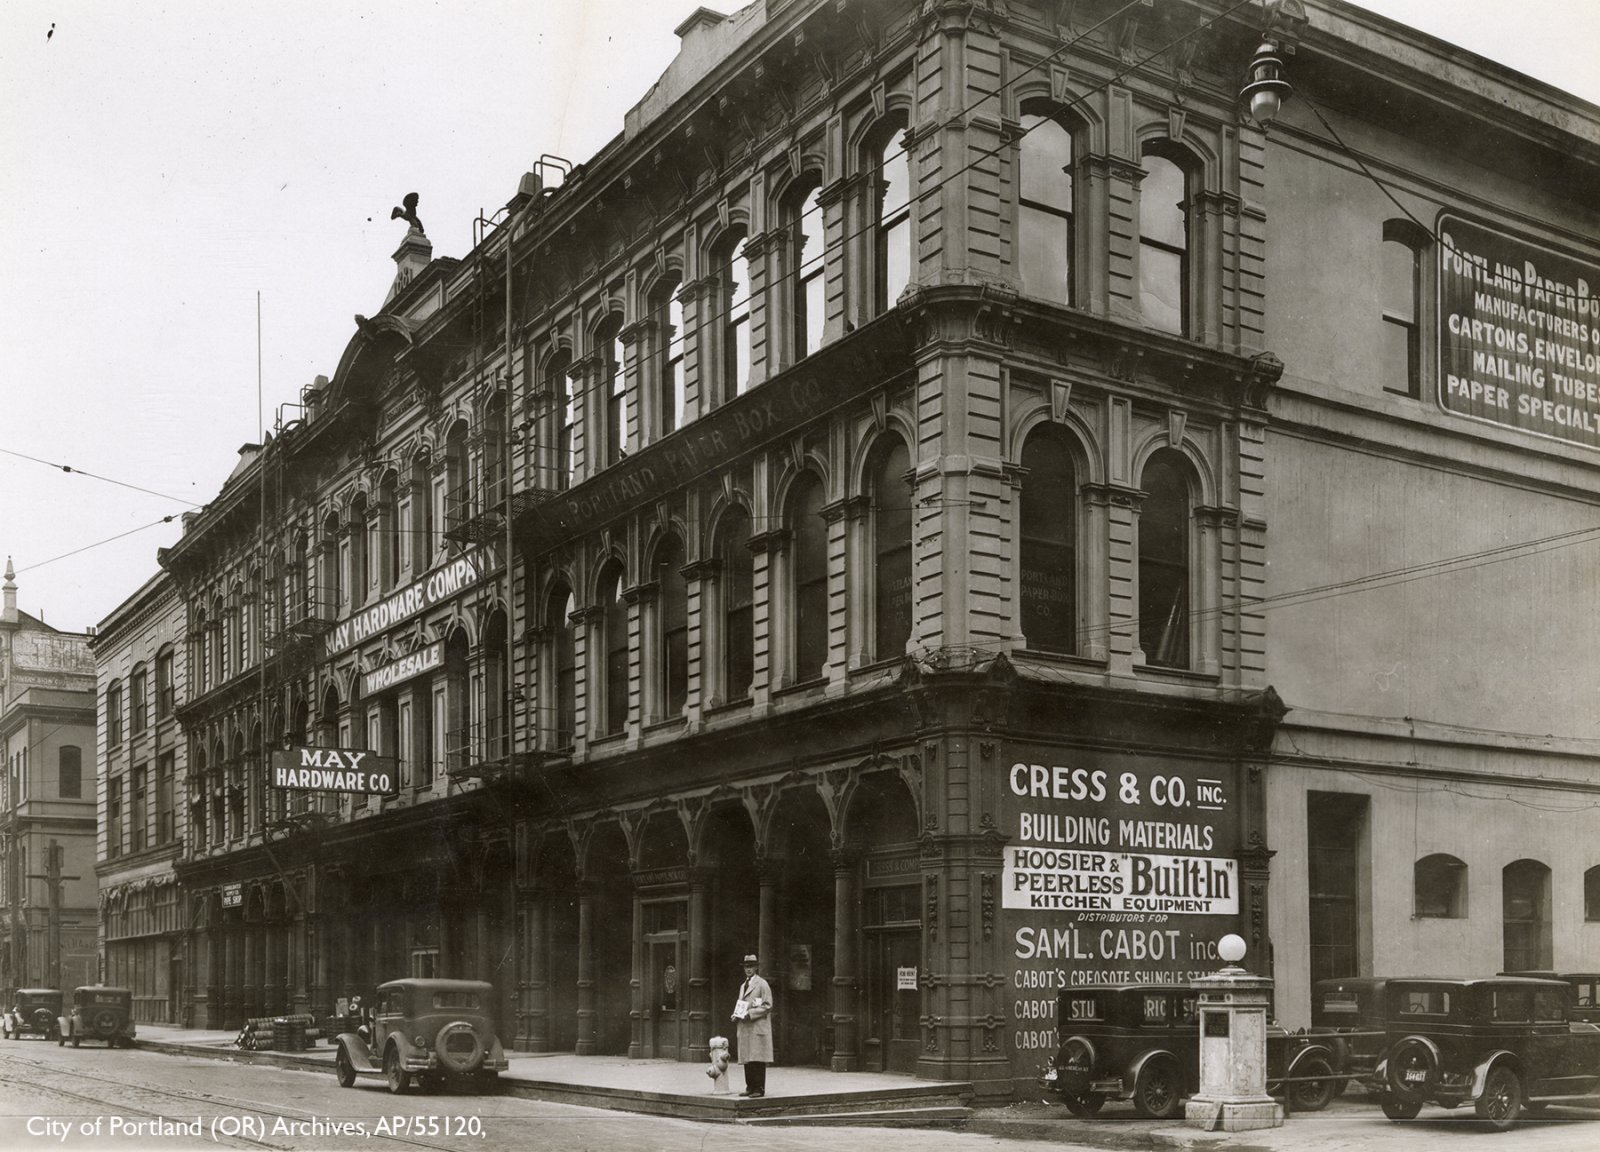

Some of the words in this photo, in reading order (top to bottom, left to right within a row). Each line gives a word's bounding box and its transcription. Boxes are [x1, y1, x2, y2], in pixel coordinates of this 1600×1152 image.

[1443, 232, 1523, 294] PORTLAND
[1525, 260, 1577, 313] PAPER
[1578, 278, 1600, 319] BO
[1448, 313, 1534, 360] CARTONS,
[1474, 291, 1589, 343] MANUFACTURERS
[1591, 327, 1600, 345] O
[1447, 373, 1510, 411] PAPER
[1473, 350, 1546, 390] MAILING
[1552, 372, 1600, 405] TUBE
[732, 399, 782, 440] BOX
[324, 622, 350, 657] MAY
[353, 583, 425, 642] HARDWARE
[367, 643, 440, 694] WHOLESALE
[301, 749, 366, 769] MAY
[276, 767, 365, 791] HARDWARE
[369, 773, 393, 792] CO.
[1009, 763, 1108, 802] CRESS
[1119, 772, 1140, 805] &
[1149, 775, 1191, 808] CO.
[1197, 785, 1227, 804] INC.
[1020, 812, 1111, 846] BUILDING
[1119, 819, 1214, 851] MATERIALS
[1013, 849, 1106, 872] HOOSIER
[1109, 858, 1120, 873] &
[1013, 871, 1124, 895] PEERLESS
[1030, 894, 1112, 910] KITCHEN
[1122, 897, 1212, 912] EQUIPMENT
[1077, 912, 1145, 923] DISTRIBUTORS
[1147, 914, 1169, 923] FOR
[1100, 928, 1180, 960] CABOT
[1190, 933, 1220, 961] inc.
[1014, 967, 1067, 989] CABOT'S
[1014, 996, 1059, 1019] CABOT'
